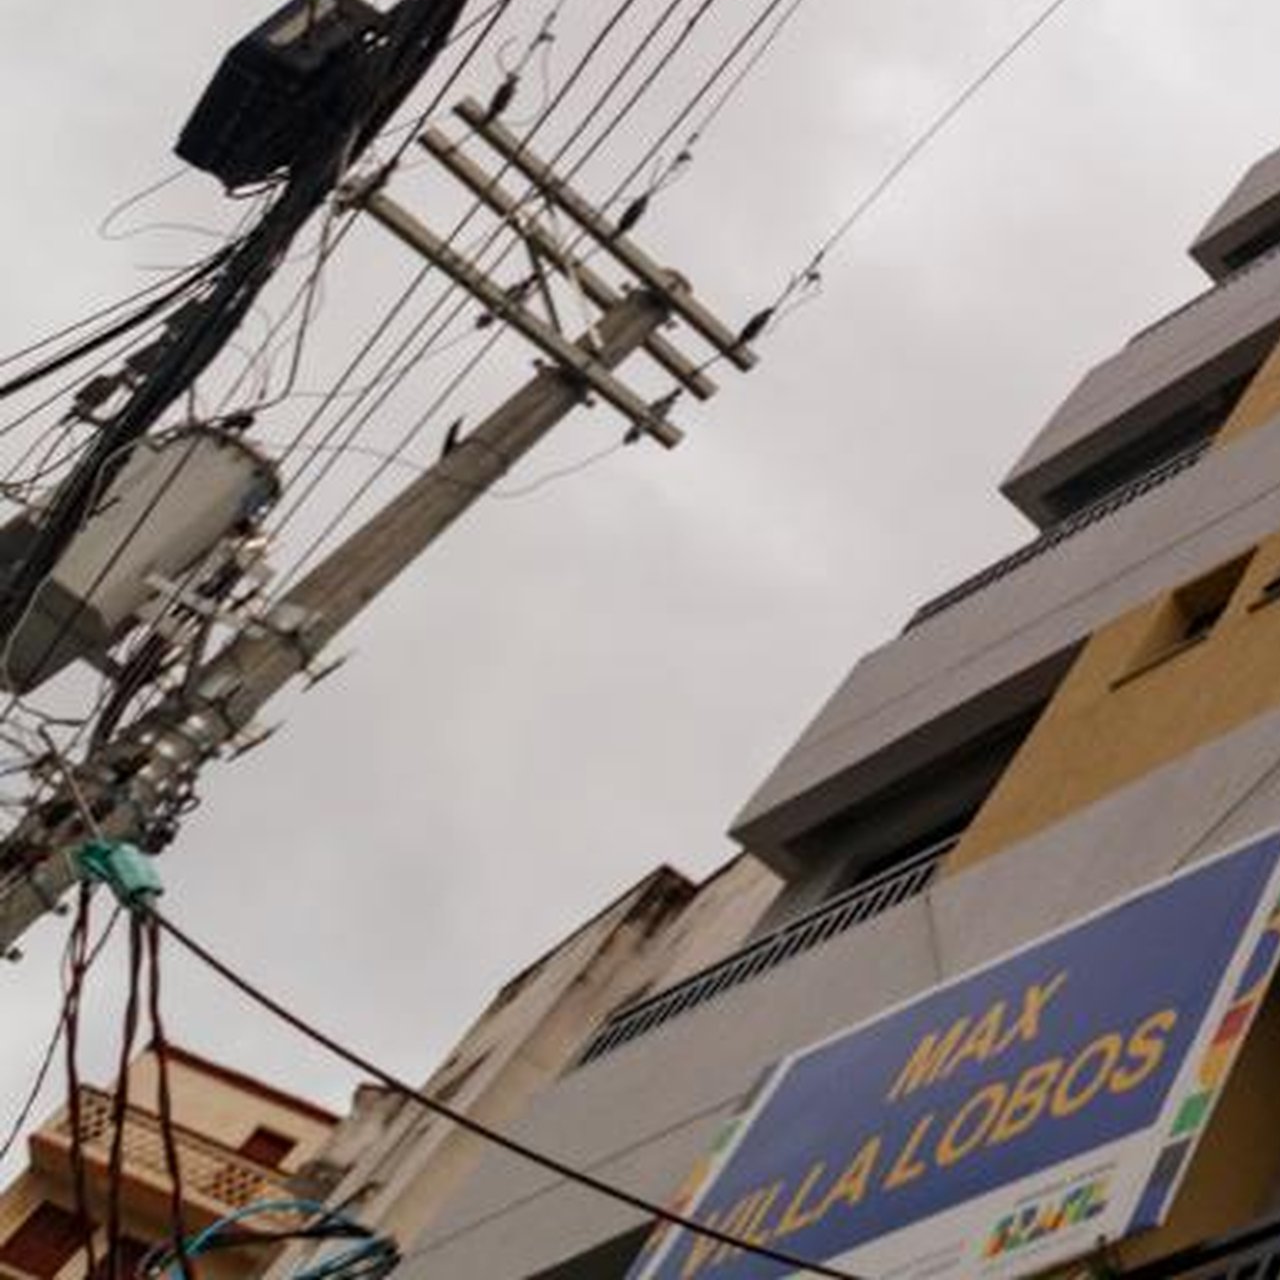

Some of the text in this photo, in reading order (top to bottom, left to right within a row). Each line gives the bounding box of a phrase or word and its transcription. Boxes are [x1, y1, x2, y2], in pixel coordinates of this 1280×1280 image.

[887, 970, 1067, 1100] MAX
[681, 1135, 881, 1280] VILLA
[882, 1009, 1178, 1191] LOBOS
